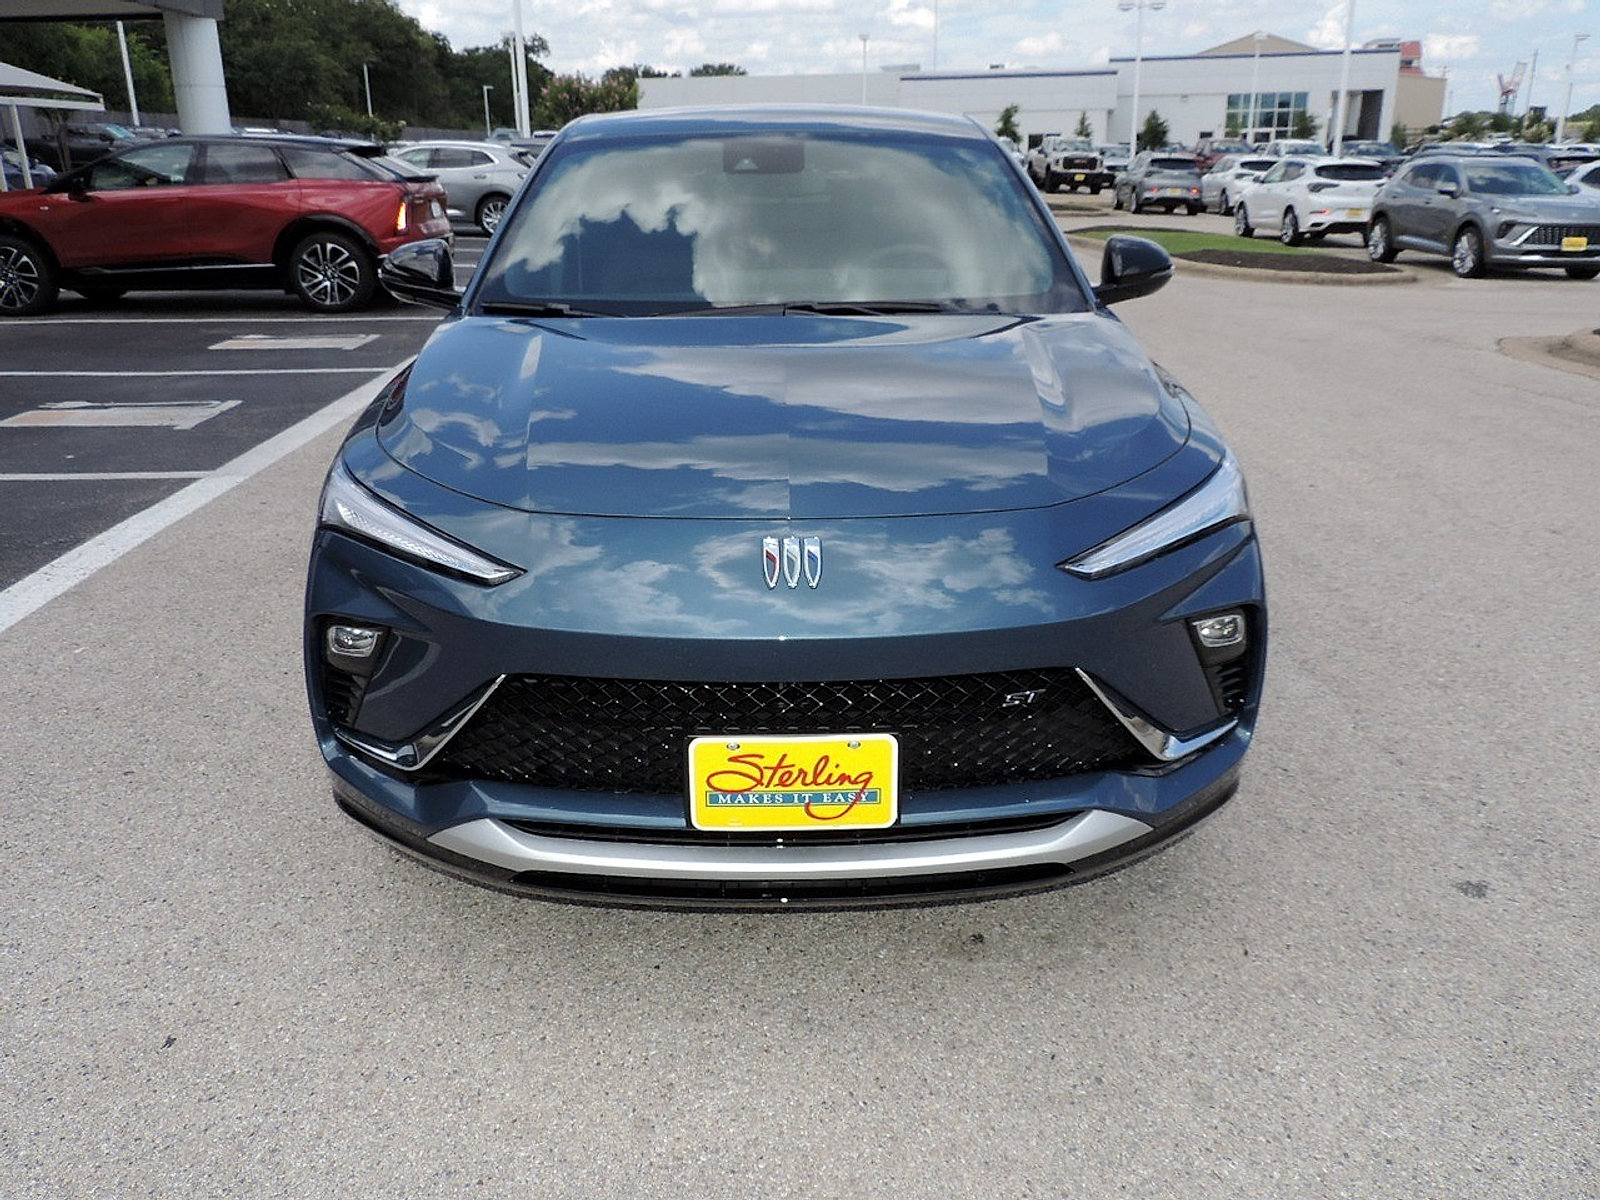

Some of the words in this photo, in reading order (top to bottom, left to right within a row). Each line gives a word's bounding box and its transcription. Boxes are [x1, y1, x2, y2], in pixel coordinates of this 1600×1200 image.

[706, 753, 874, 821] Sterling
[717, 793, 784, 805] MAKES
[793, 793, 815, 804] IT
[822, 792, 870, 804] EASY
